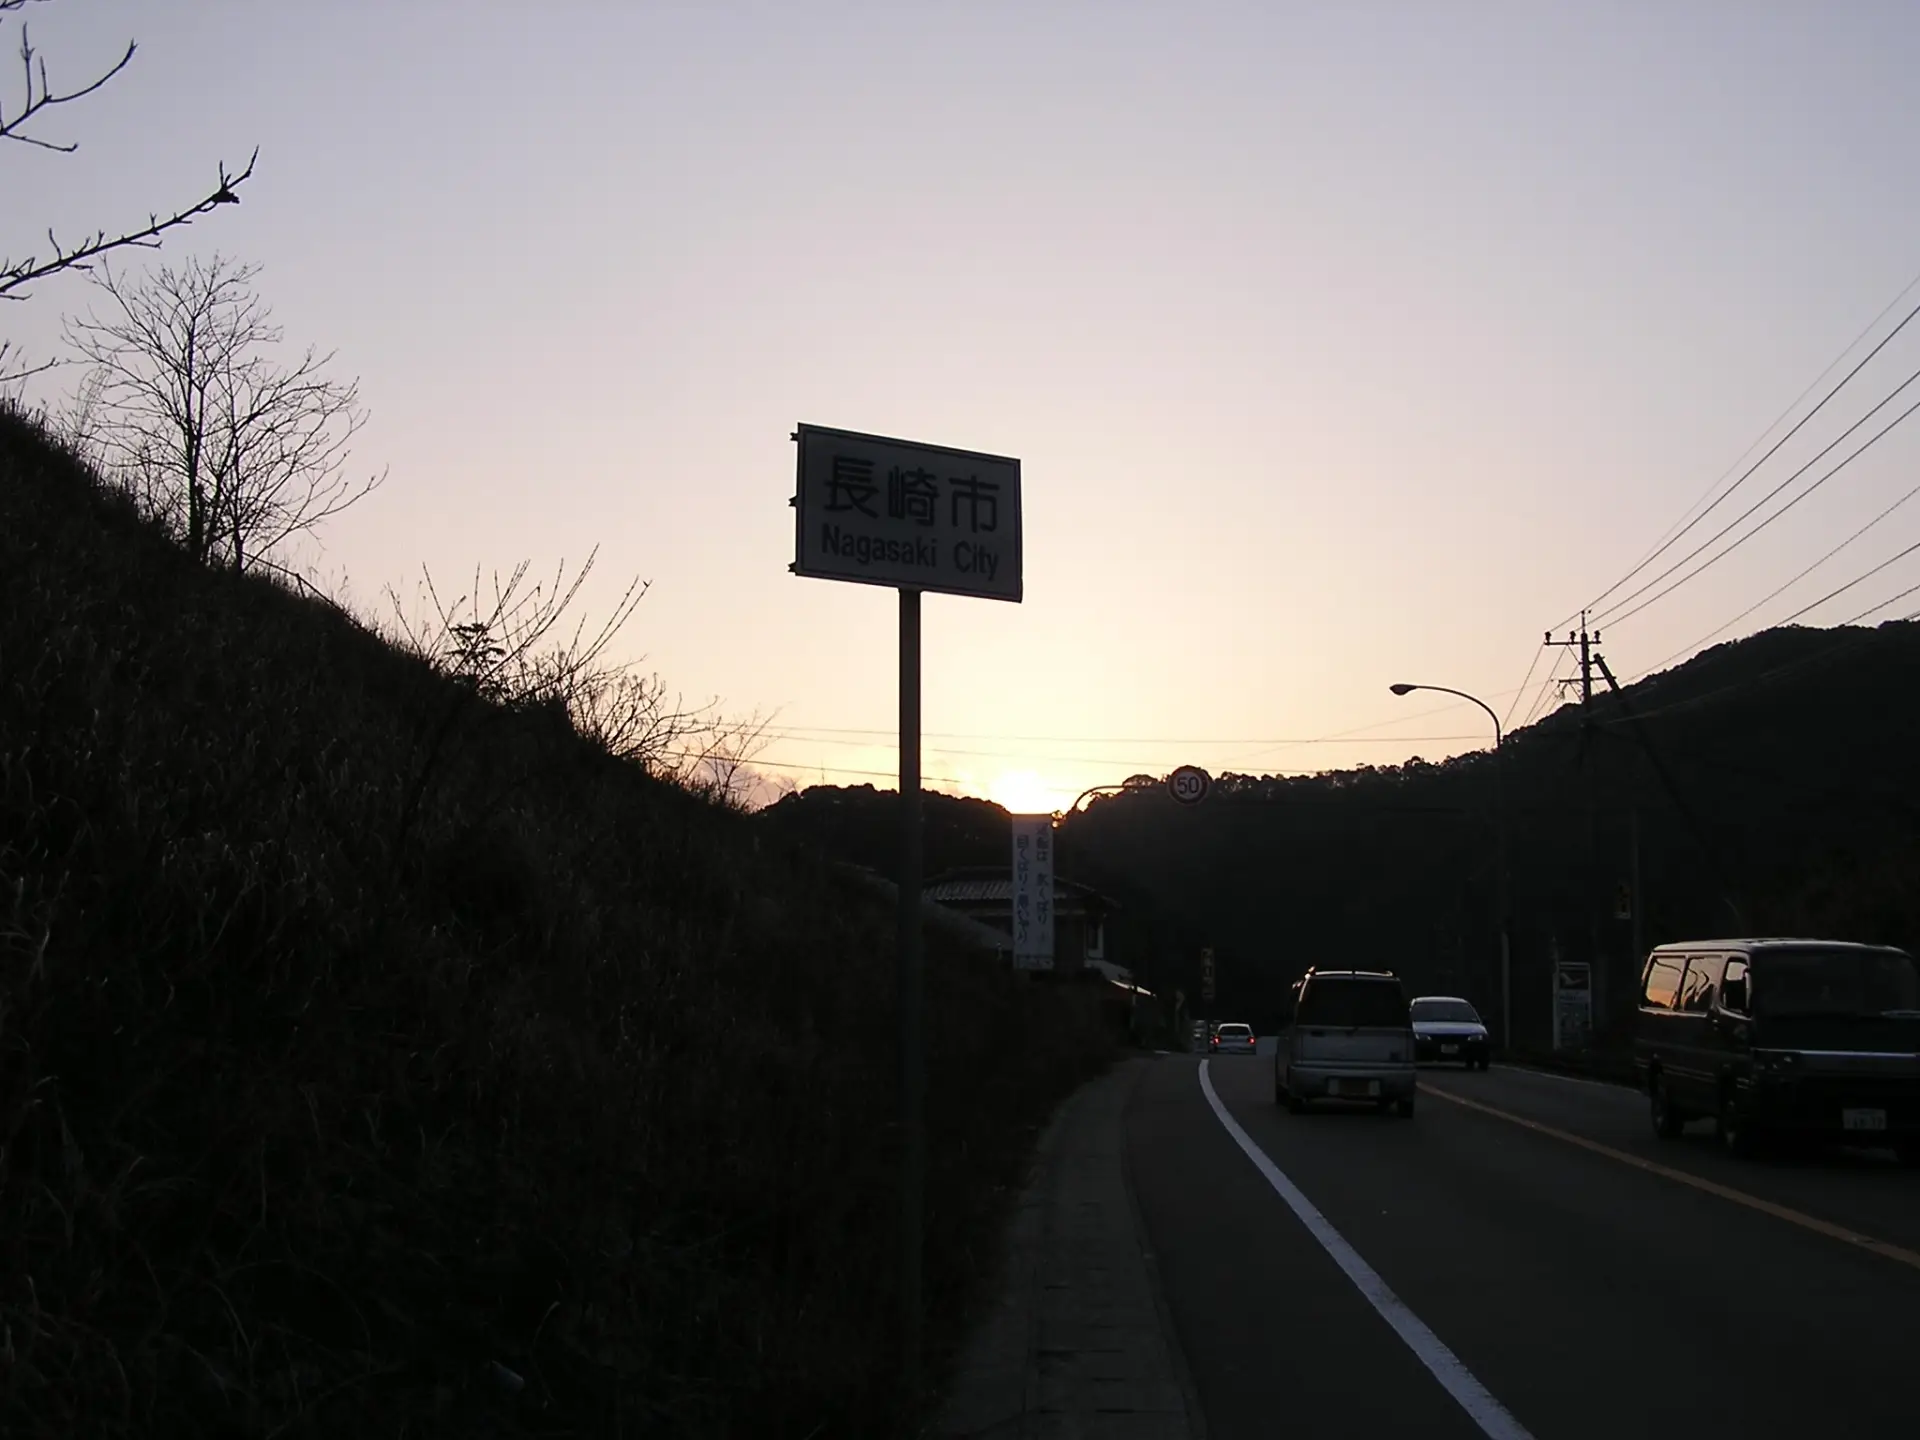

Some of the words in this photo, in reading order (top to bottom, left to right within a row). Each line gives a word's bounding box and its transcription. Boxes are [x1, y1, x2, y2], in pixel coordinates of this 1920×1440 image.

[823, 455, 1000, 533] 長崎市
[822, 523, 938, 568] Nagasaki
[953, 540, 999, 581] City
[1177, 776, 1199, 794] 50
